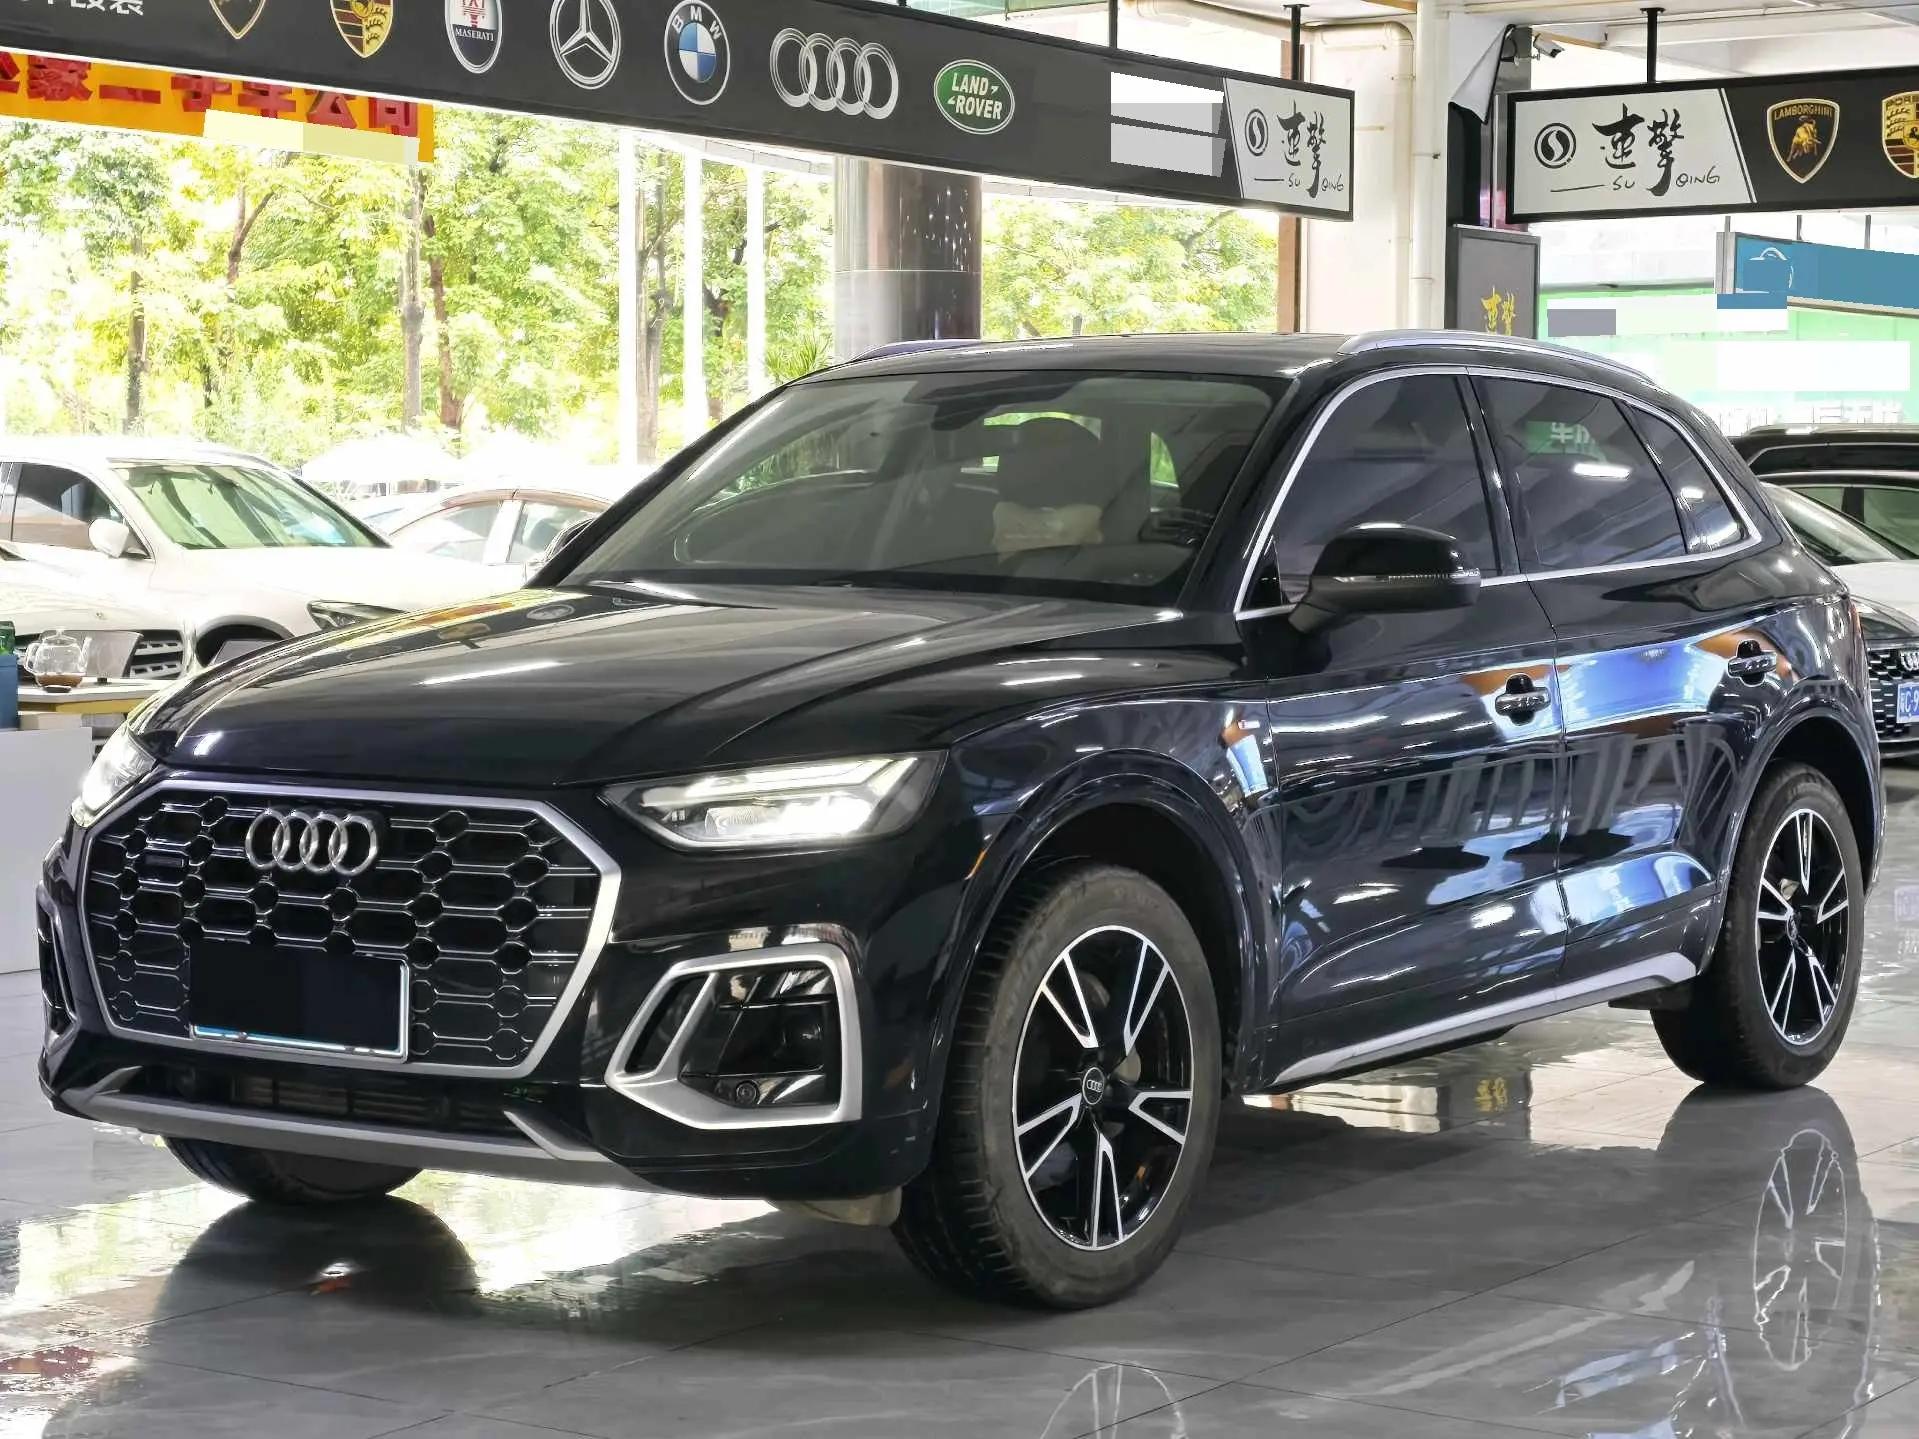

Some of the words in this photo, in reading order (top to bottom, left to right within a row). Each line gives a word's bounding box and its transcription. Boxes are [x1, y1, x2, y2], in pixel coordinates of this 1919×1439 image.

[455, 27, 494, 41] MASERATI
[672, 5, 722, 40] BMW
[951, 72, 989, 96] LAND
[955, 94, 1003, 120] ROVER
[1774, 104, 1834, 121] LAMBORGHINI
[1612, 175, 1636, 192] SU
[1675, 164, 1721, 188] QING
